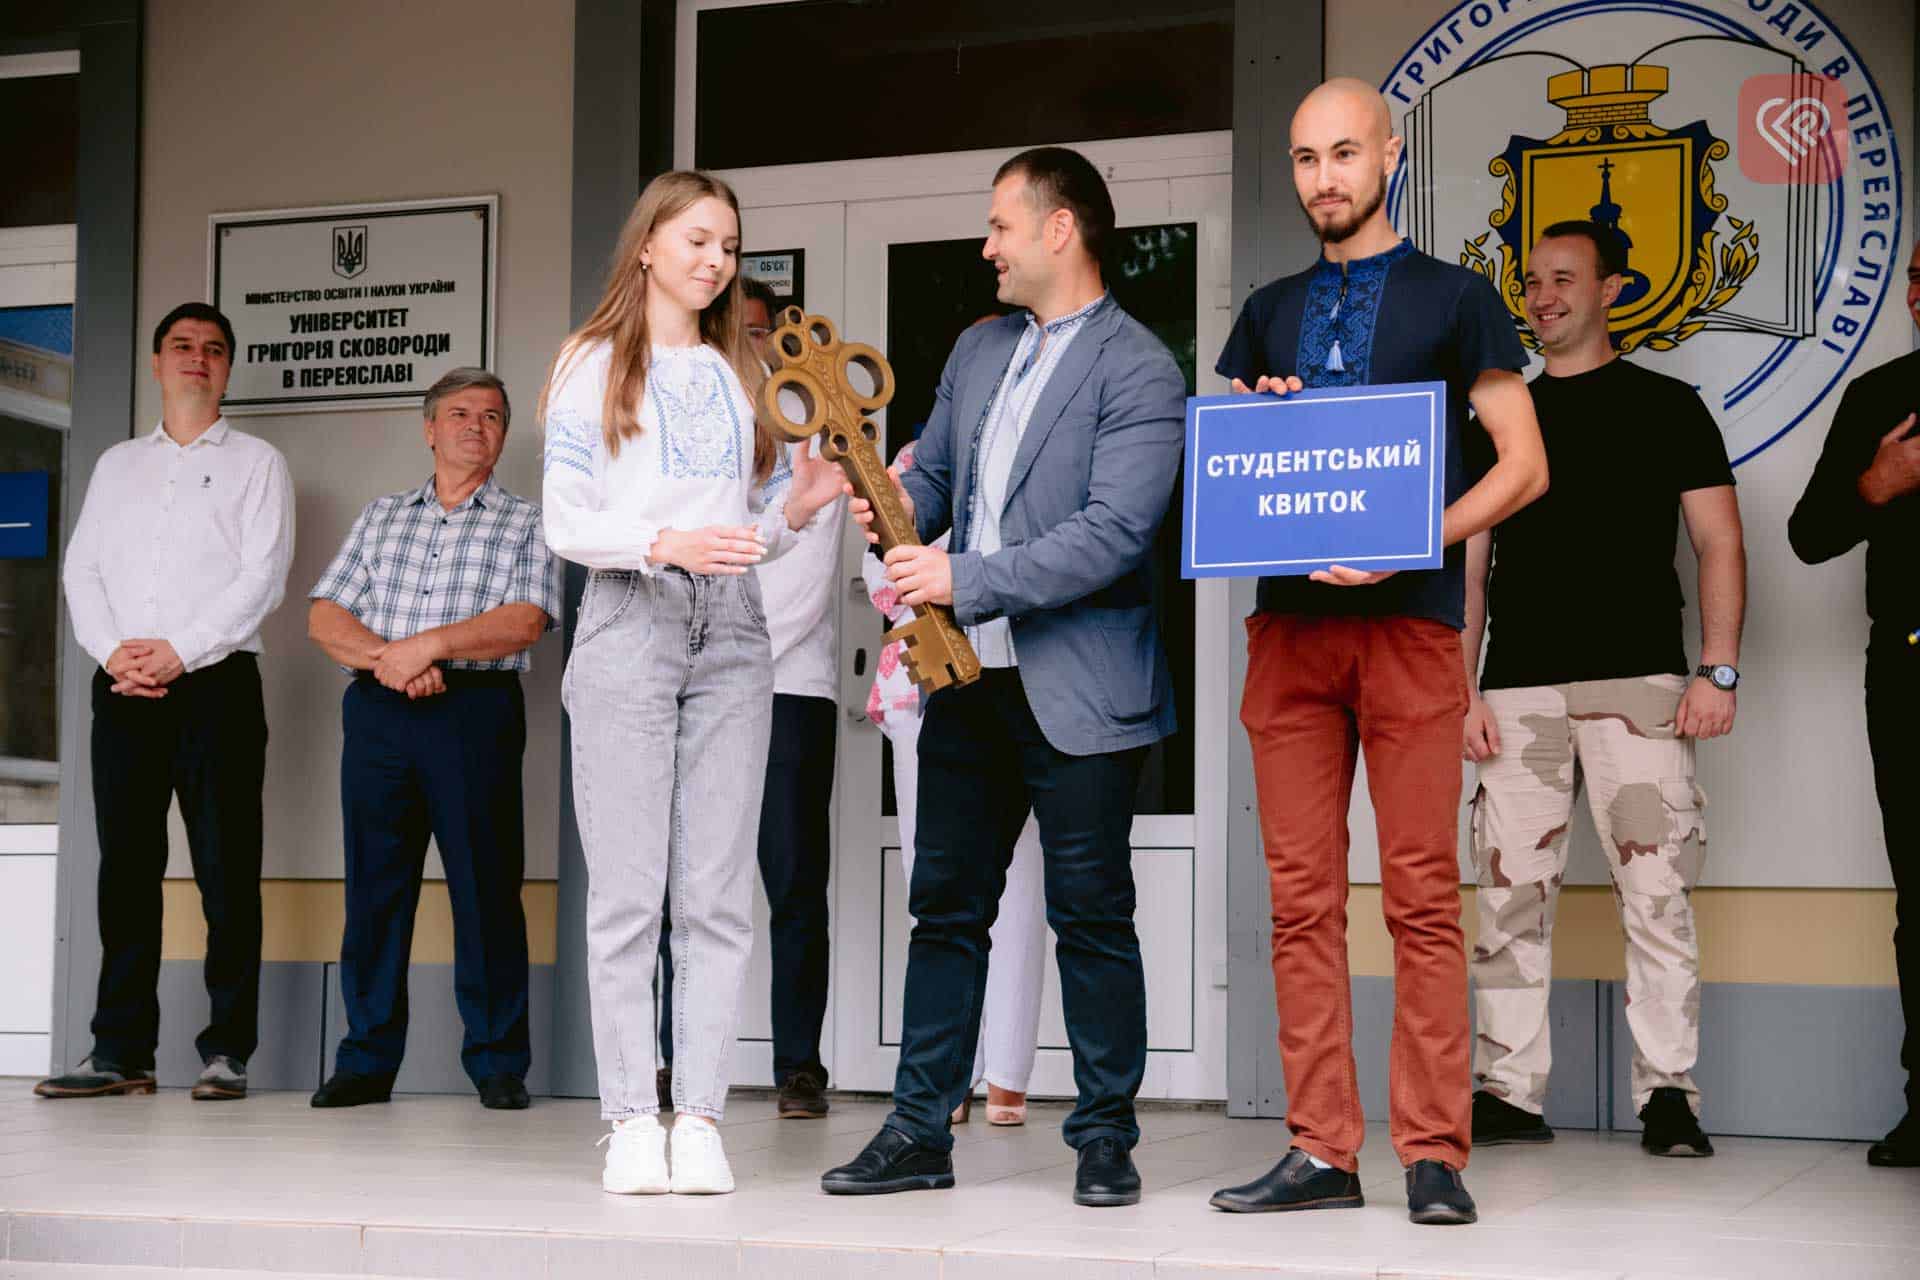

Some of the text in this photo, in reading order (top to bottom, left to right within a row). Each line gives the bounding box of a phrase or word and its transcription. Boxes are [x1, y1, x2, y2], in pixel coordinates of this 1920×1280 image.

[1822, 56, 1850, 81] В
[1821, 93, 1890, 354] ПЕРЕЯСЛАВІ
[245, 280, 455, 304] МІНІСТЕРСТВО ОСВІТИ І НАУКИ УКРАЇНИ
[289, 308, 409, 334] УНІВЕРСИТЕТ
[247, 333, 451, 363] ГРИГОРІЯ СКОВОРОДИ
[282, 363, 413, 389] В ПЕРЕЯСЛАВІ
[1207, 439, 1421, 479] СТУДЕНТСЬКИЙ
[1258, 490, 1367, 517] КВИТОК
